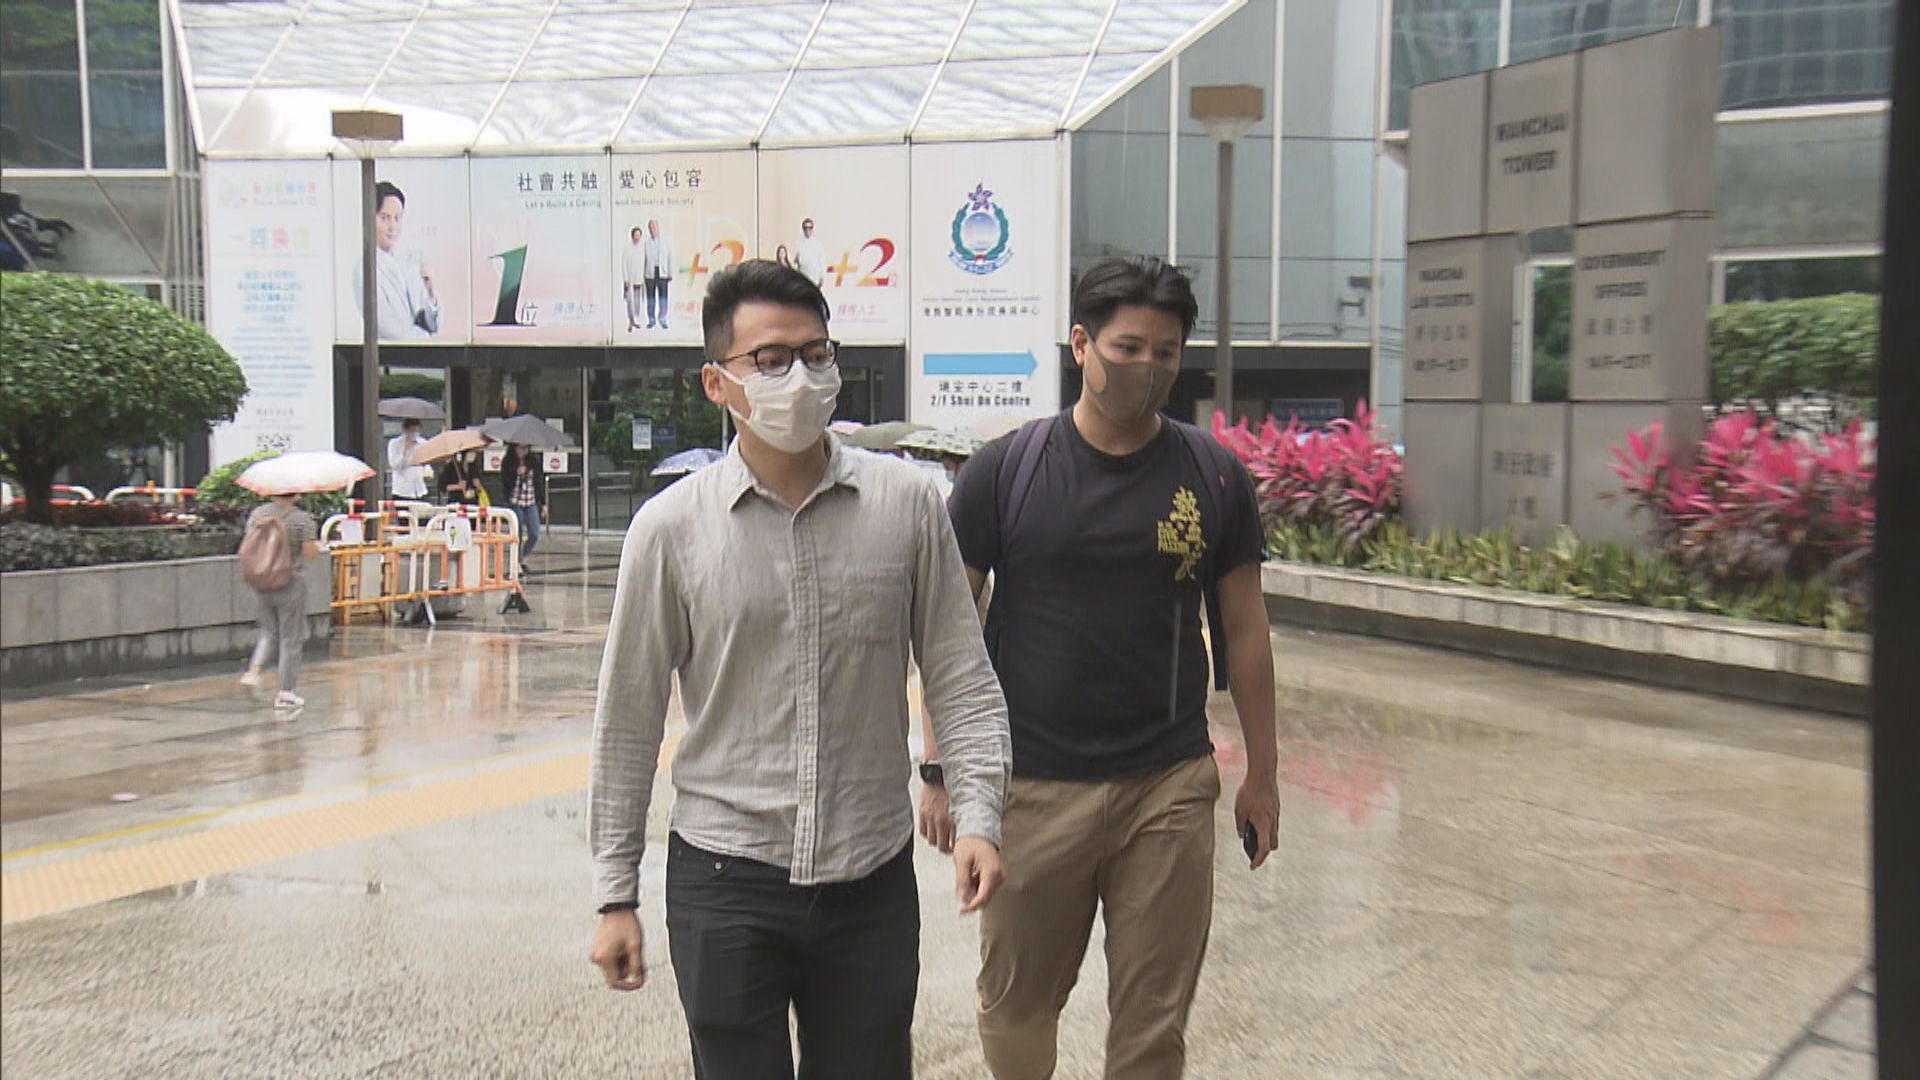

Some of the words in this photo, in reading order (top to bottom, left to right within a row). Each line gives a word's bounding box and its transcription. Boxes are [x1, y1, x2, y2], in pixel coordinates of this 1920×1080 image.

[1503, 150, 1556, 175] TOWER
[517, 171, 599, 192] 社會共融
[619, 169, 702, 190] 愛心包容
[546, 199, 567, 209] Build
[576, 198, 602, 209] Caring
[994, 395, 1031, 406] Centre
